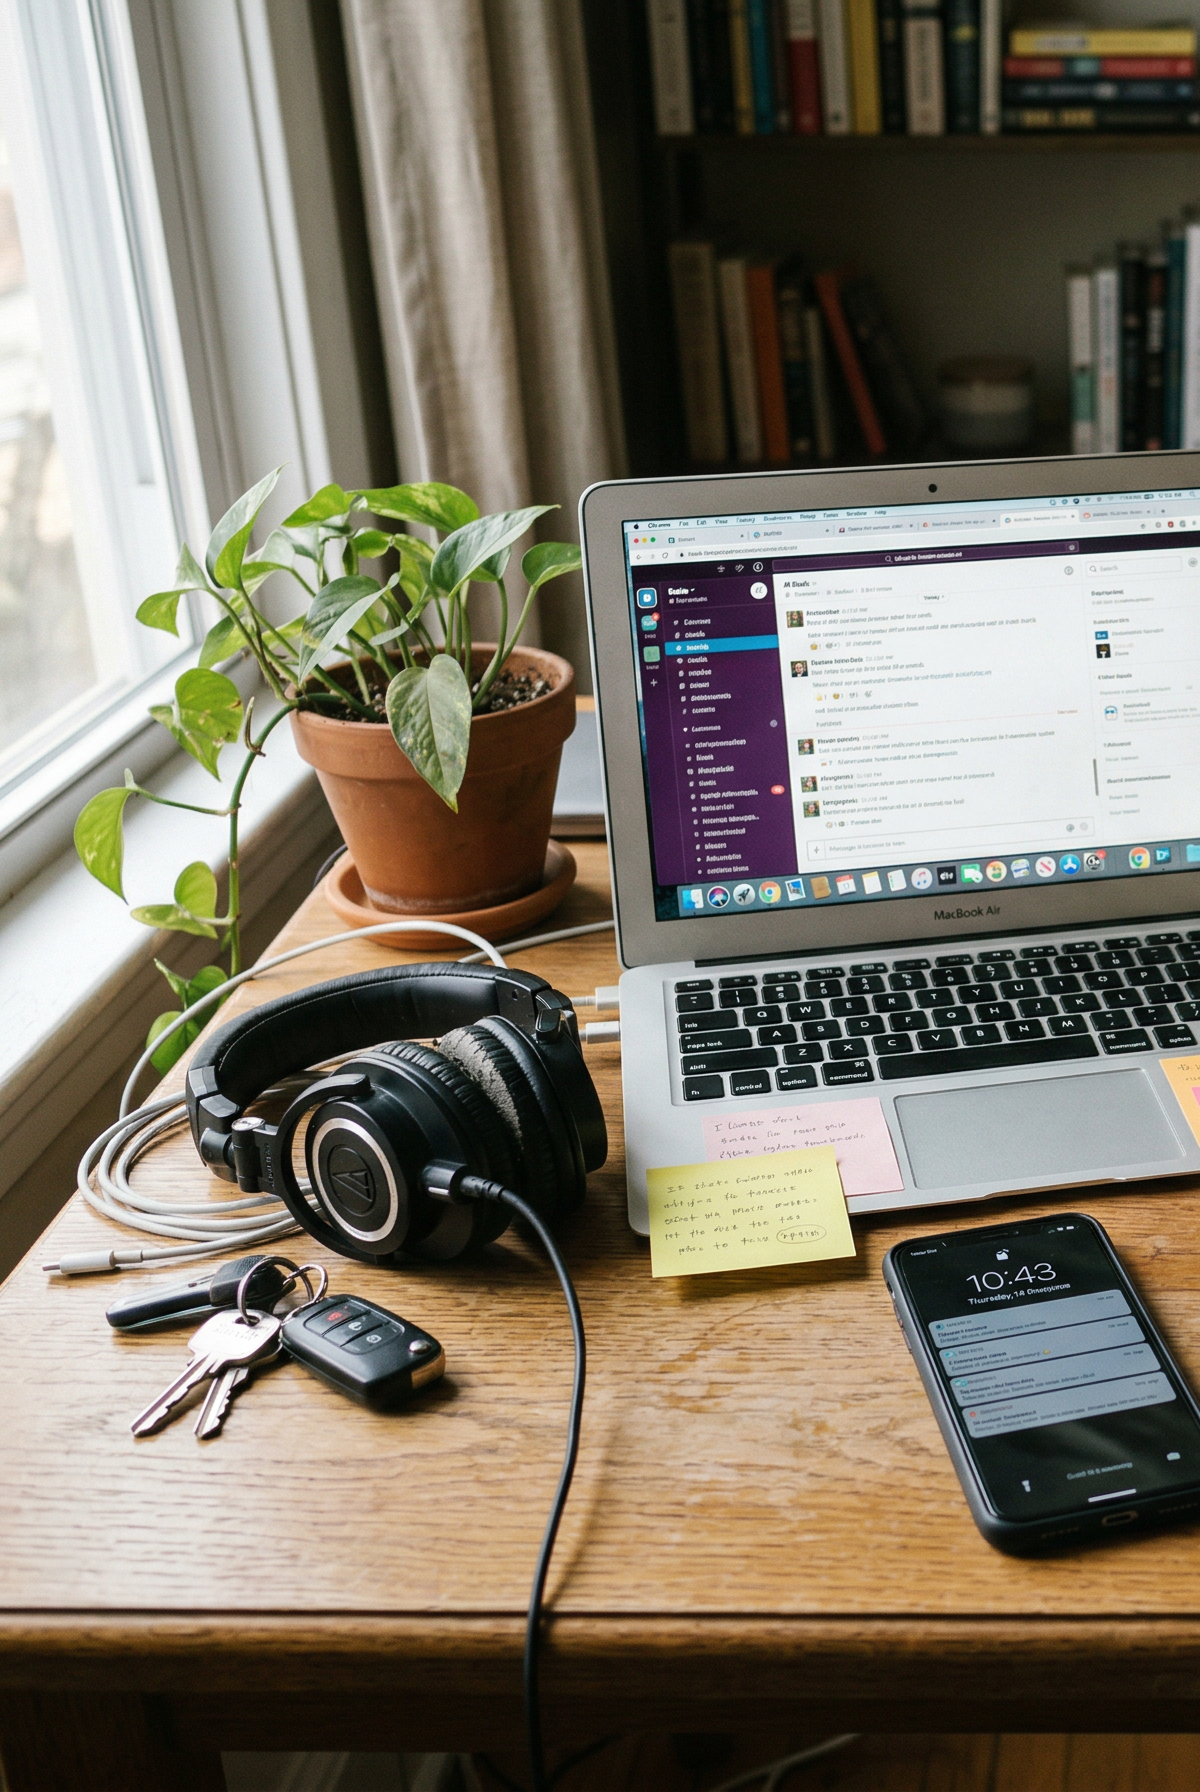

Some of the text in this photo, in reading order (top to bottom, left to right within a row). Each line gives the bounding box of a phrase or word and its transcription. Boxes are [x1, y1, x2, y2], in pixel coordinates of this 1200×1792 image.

[934, 905, 1001, 920] MacBook Air
[1140, 971, 1148, 979] P
[972, 988, 981, 996] Y
[1014, 984, 1024, 992] U
[845, 1001, 853, 1009] E
[799, 1005, 812, 1014] W
[1061, 1020, 1075, 1028] M
[816, 1025, 825, 1033] S
[1018, 1024, 1030, 1033] N
[772, 1030, 782, 1038] A
[976, 1029, 985, 1037] B
[843, 1043, 853, 1051] X
[887, 1039, 897, 1047] C
[798, 1048, 807, 1056] Z
[966, 1262, 1057, 1293] 10:43
